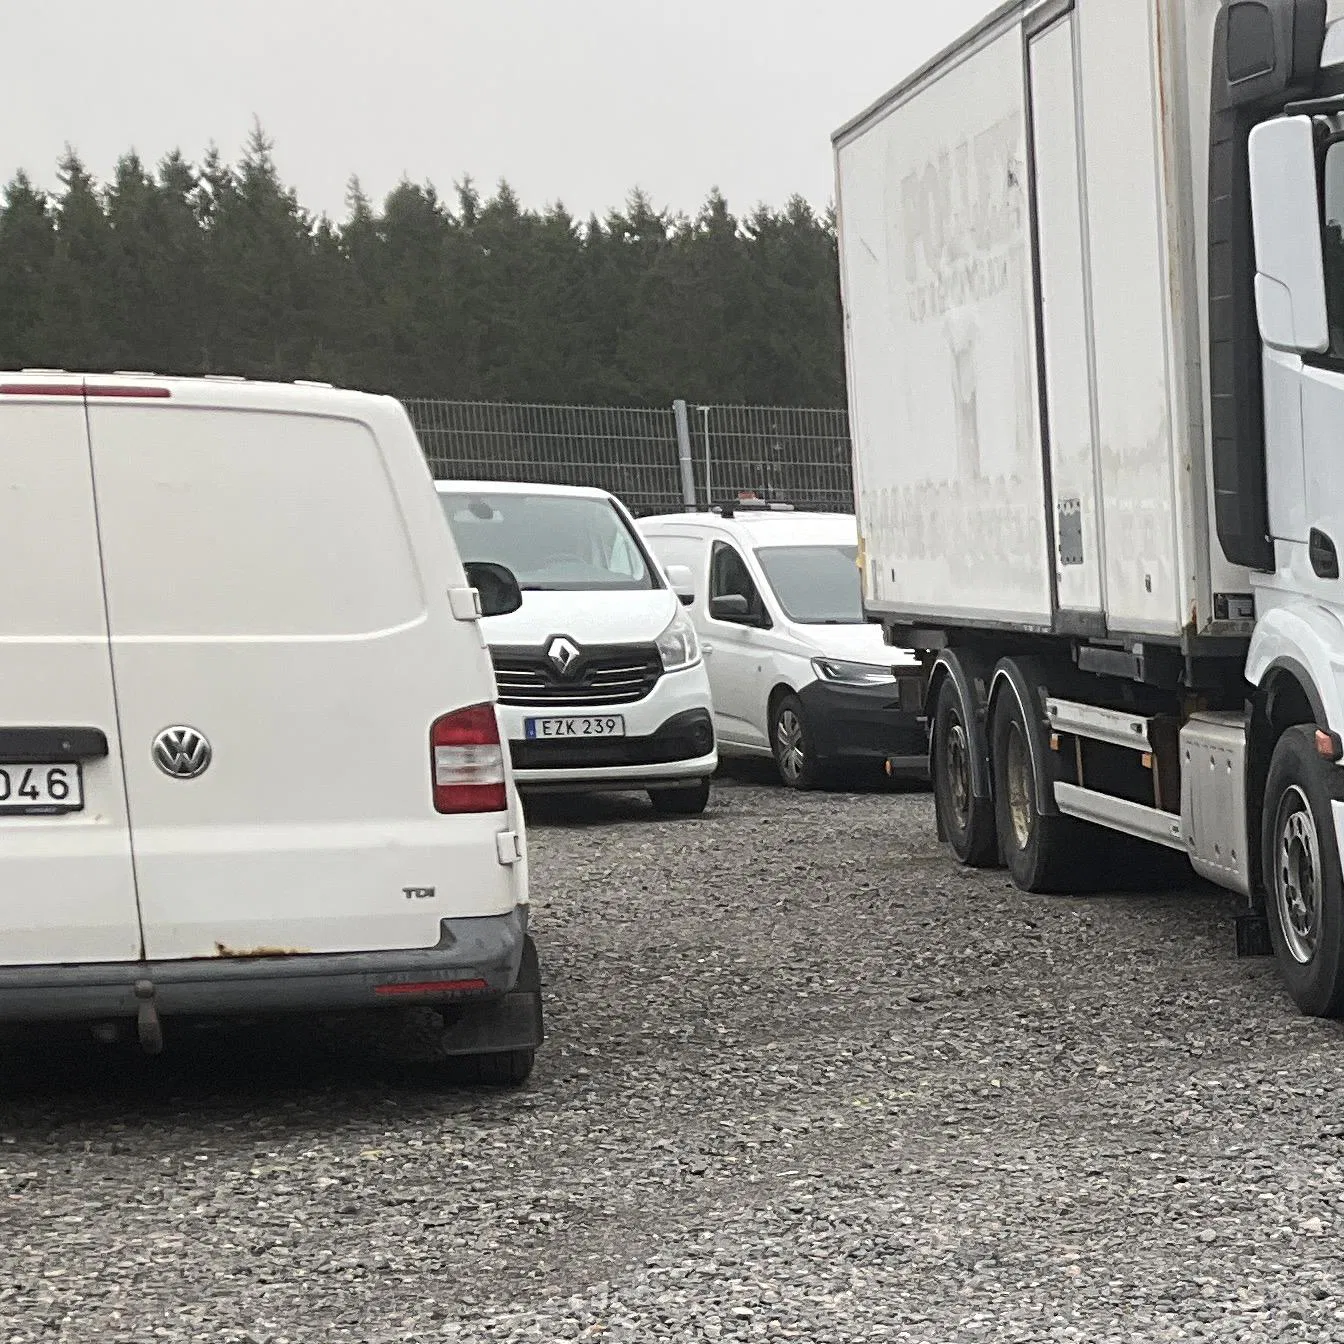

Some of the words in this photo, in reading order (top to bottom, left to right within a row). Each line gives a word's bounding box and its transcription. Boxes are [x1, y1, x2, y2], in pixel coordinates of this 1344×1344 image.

[542, 719, 577, 736] EZK
[582, 718, 616, 735] 239
[402, 886, 435, 899] TDI
